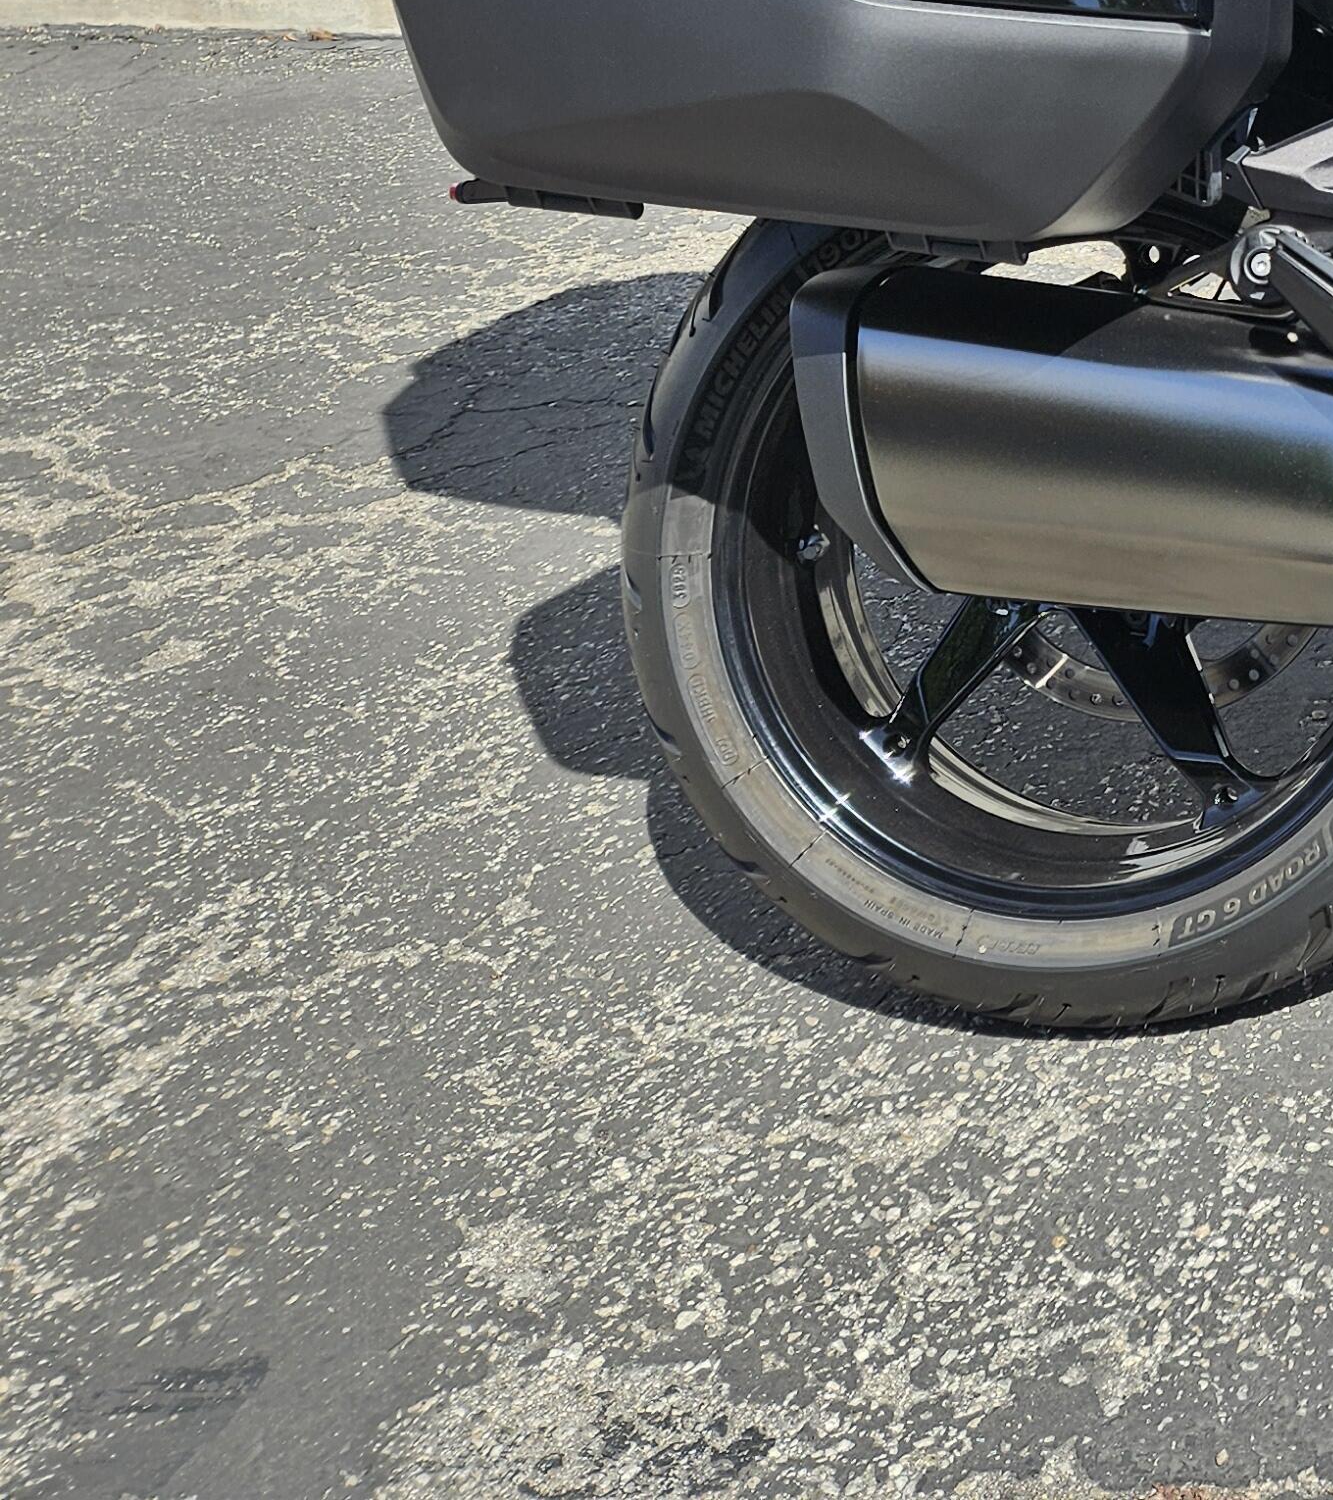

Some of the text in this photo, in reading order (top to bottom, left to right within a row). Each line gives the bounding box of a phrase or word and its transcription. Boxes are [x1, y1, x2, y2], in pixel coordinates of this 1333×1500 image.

[696, 282, 793, 444] MICHELIN
[1250, 839, 1321, 906] ROAD
[863, 900, 895, 920] SPAIN
[1223, 898, 1242, 915] 6
[912, 924, 945, 940] MADE
[1177, 910, 1217, 941] GT
